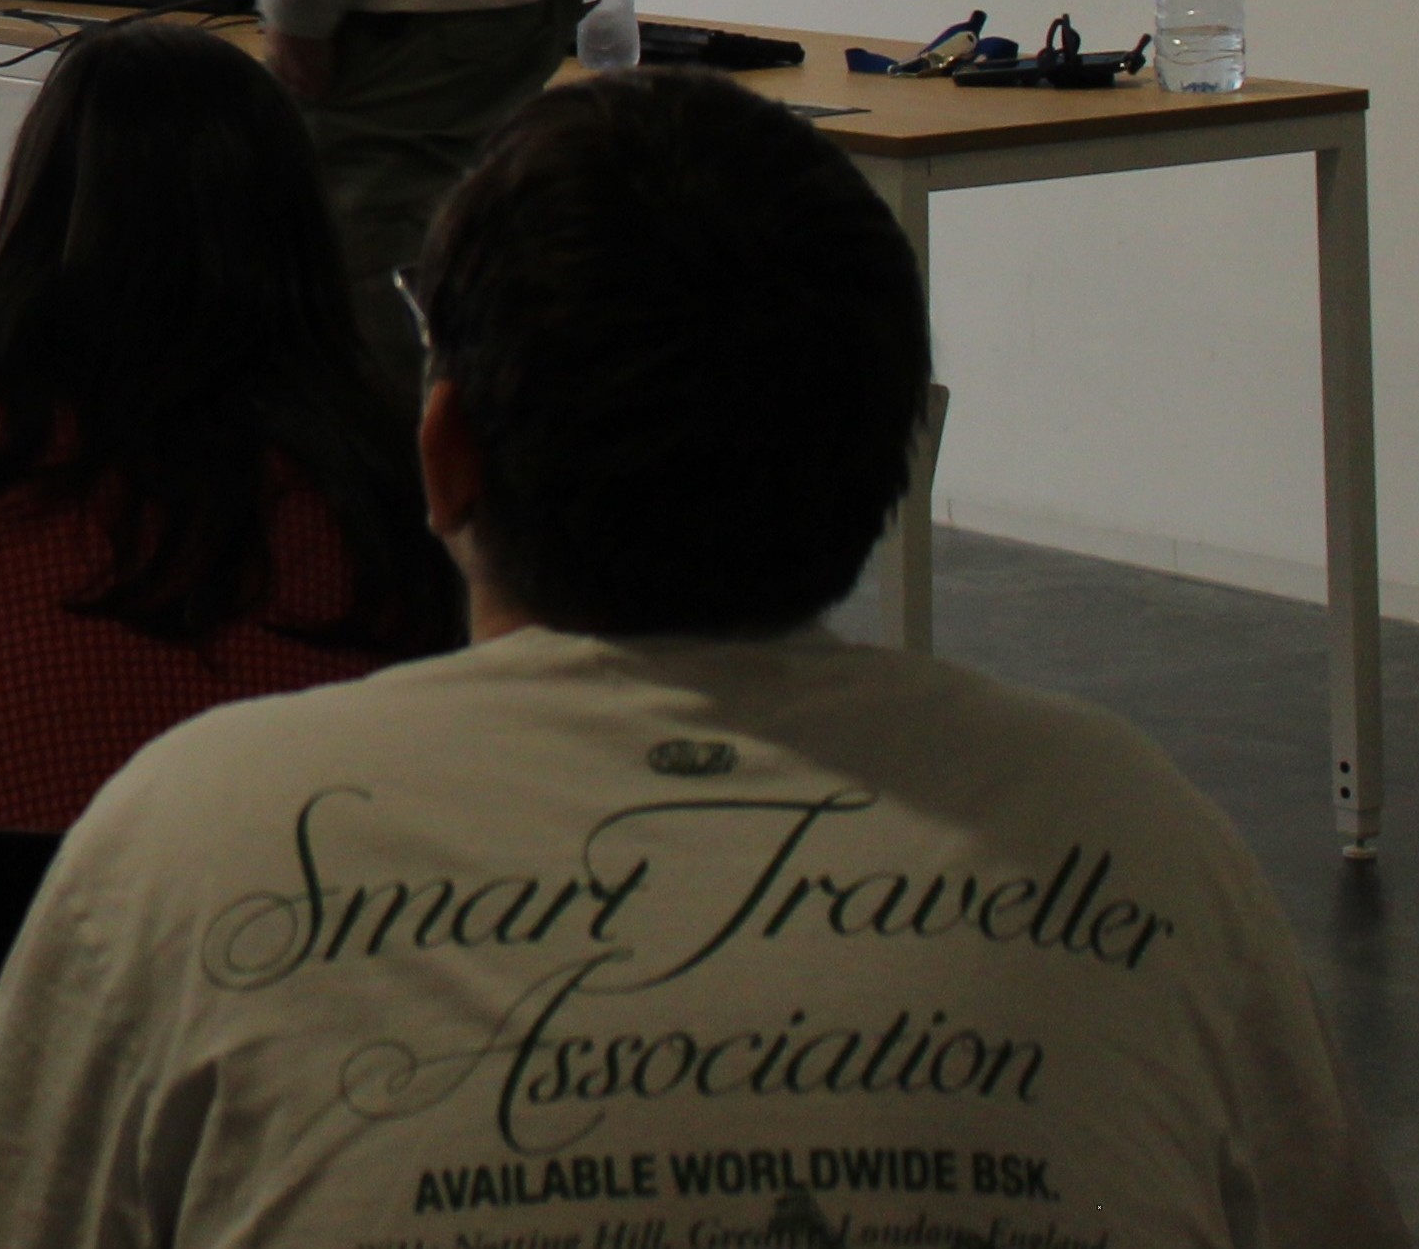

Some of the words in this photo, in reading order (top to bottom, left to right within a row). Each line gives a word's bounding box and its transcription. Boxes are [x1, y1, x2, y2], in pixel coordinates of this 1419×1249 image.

[202, 784, 650, 993] Smart
[583, 788, 1176, 993] Traveller
[340, 949, 1044, 1155] Association
[414, 1151, 658, 1215] AVAILABLE
[671, 1147, 958, 1196] WORLDWIDE
[971, 1149, 1061, 1201] BSK.
